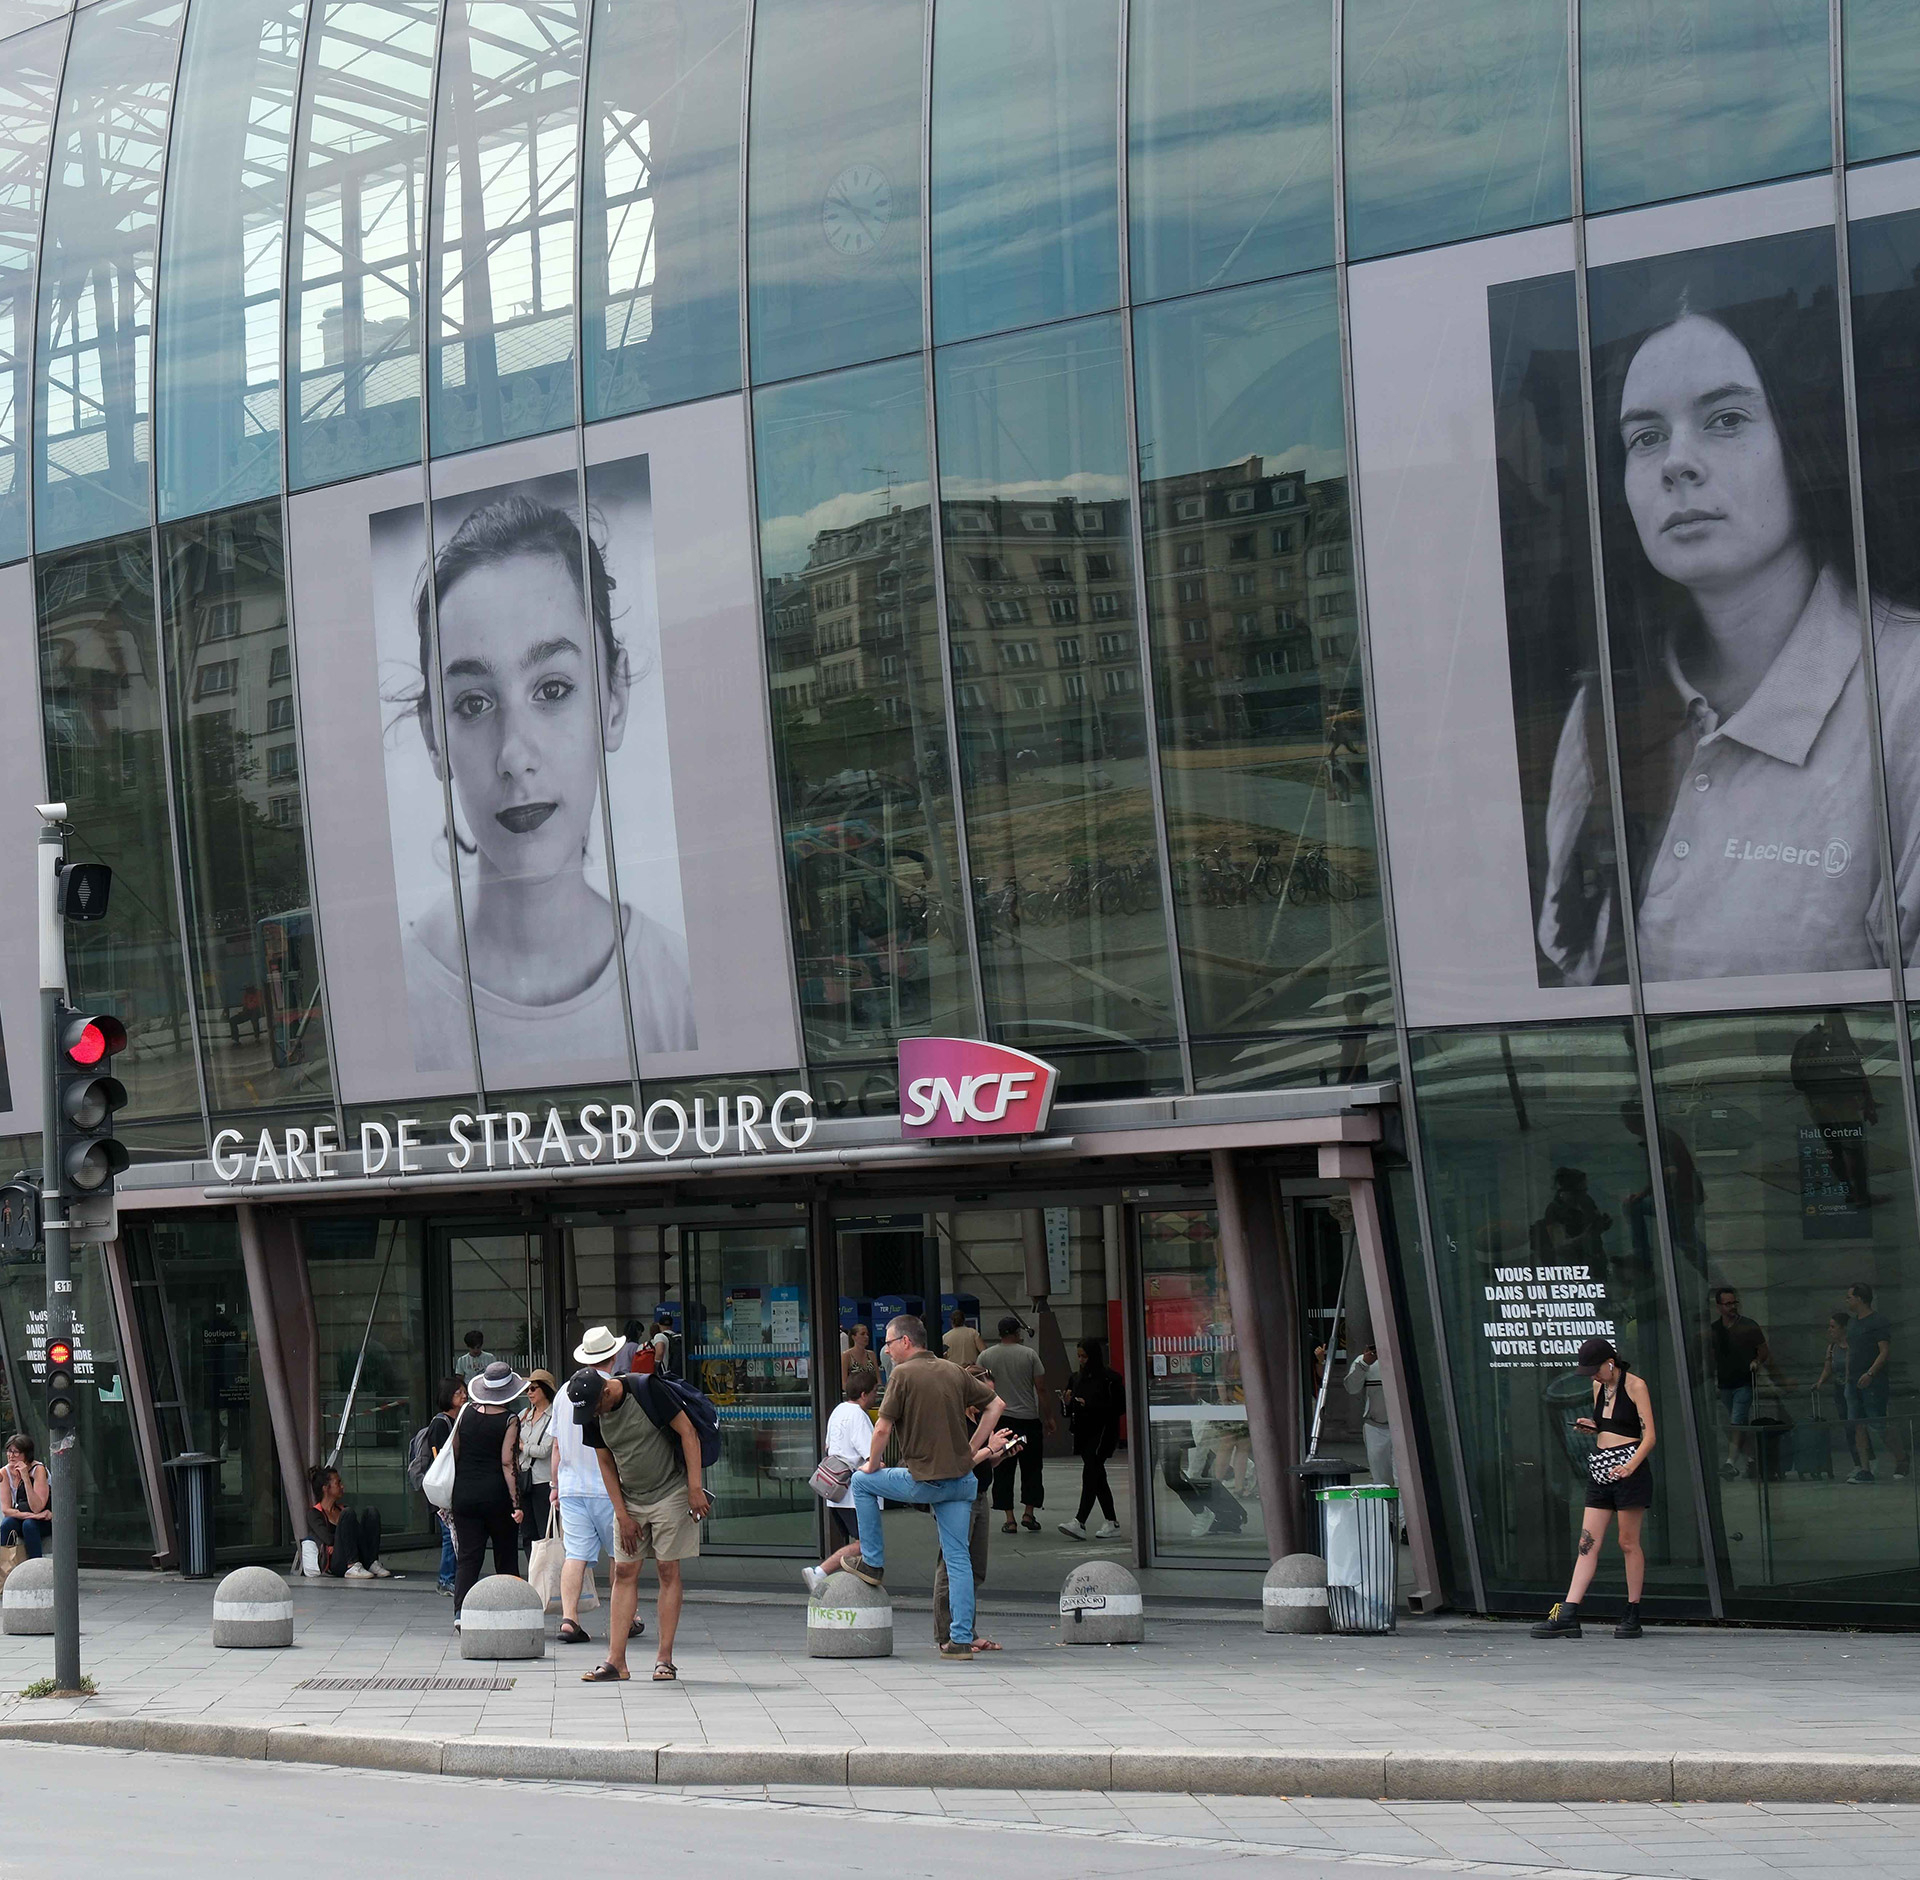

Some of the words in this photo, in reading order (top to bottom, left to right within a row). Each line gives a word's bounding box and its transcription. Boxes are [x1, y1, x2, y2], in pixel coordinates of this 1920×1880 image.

[1724, 838, 1820, 866] E.Leclerc
[903, 1072, 1036, 1126] SNCF
[212, 1125, 338, 1181] GARE
[361, 1119, 422, 1174] DE
[447, 1090, 817, 1169] STRASBOURG
[1800, 1128, 1821, 1139] Hall
[1823, 1126, 1863, 1138] Central
[1494, 1267, 1533, 1282] VOUS
[1536, 1265, 1591, 1281] ENTREZ
[1484, 1286, 1524, 1301] DANS
[1527, 1285, 1547, 1300] UN
[1550, 1283, 1606, 1299] ESPACE
[1500, 1302, 1596, 1319] NON-FUMEUR
[26, 1323, 45, 1335] DANS
[204, 1329, 236, 1338] Boutiques
[1483, 1322, 1529, 1337] MERCI
[1532, 1318, 1616, 1337] D'ÉTEINDRE
[26, 1350, 47, 1361] MERC
[1491, 1339, 1537, 1355] VOTRE
[32, 1363, 47, 1374] VOT
